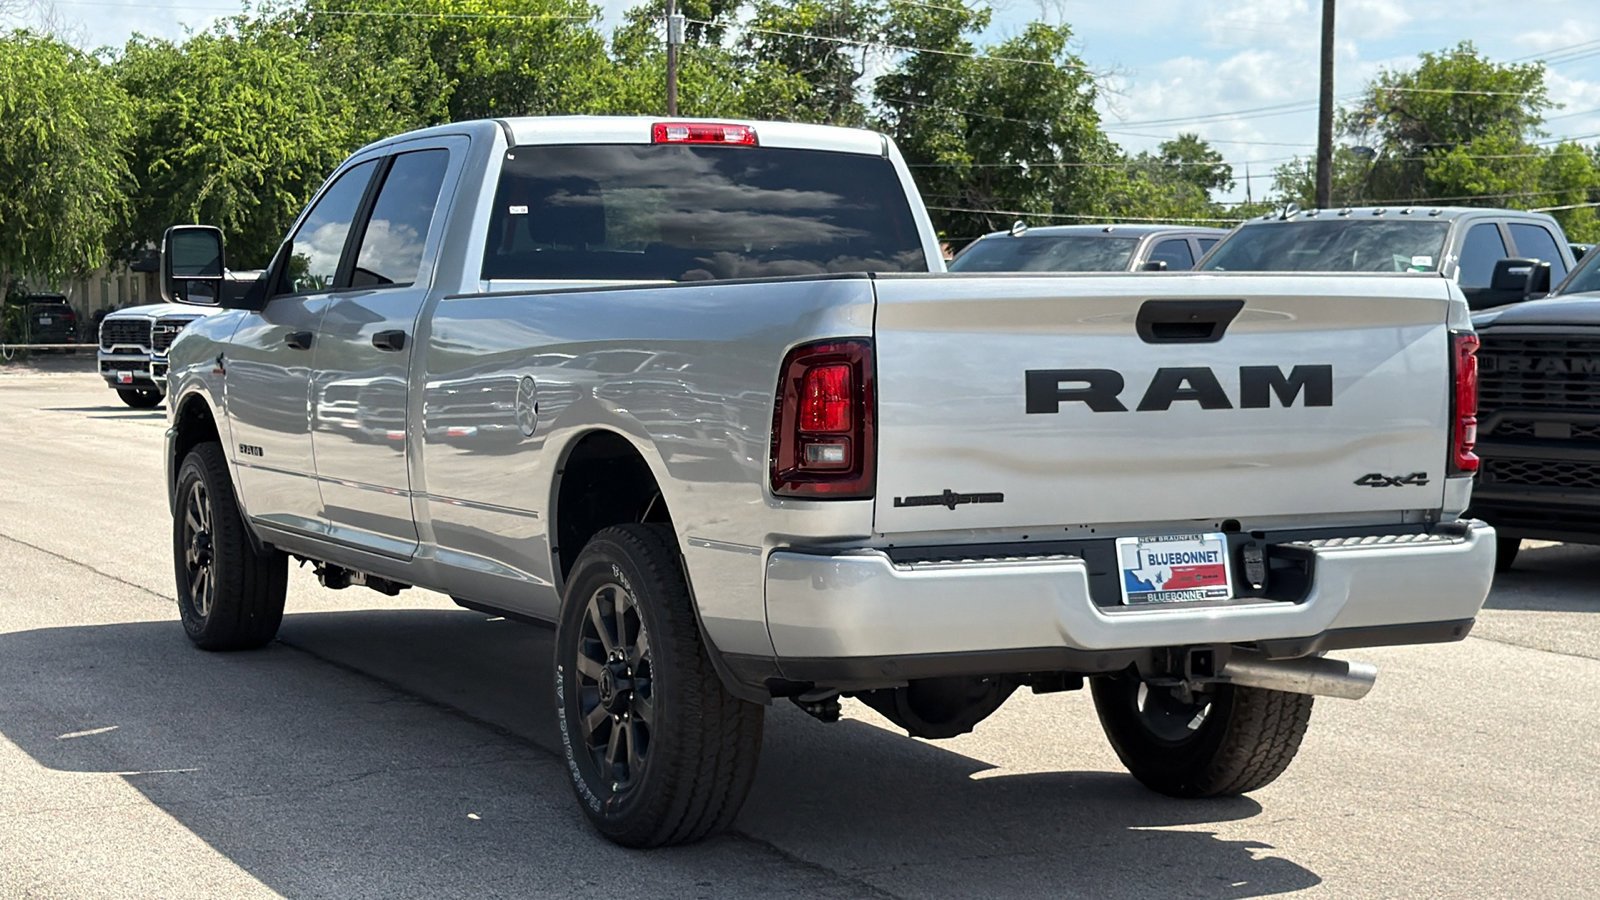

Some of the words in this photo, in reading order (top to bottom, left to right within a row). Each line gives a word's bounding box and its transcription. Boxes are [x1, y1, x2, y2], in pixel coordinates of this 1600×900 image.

[1026, 364, 1333, 414] RAM
[239, 443, 263, 457] RAM
[1353, 472, 1430, 488] 4x4
[1158, 534, 1203, 542] BRAUNFELS
[1148, 551, 1218, 566] BLUEBONNET
[1147, 590, 1207, 602] BLUEBONNET
